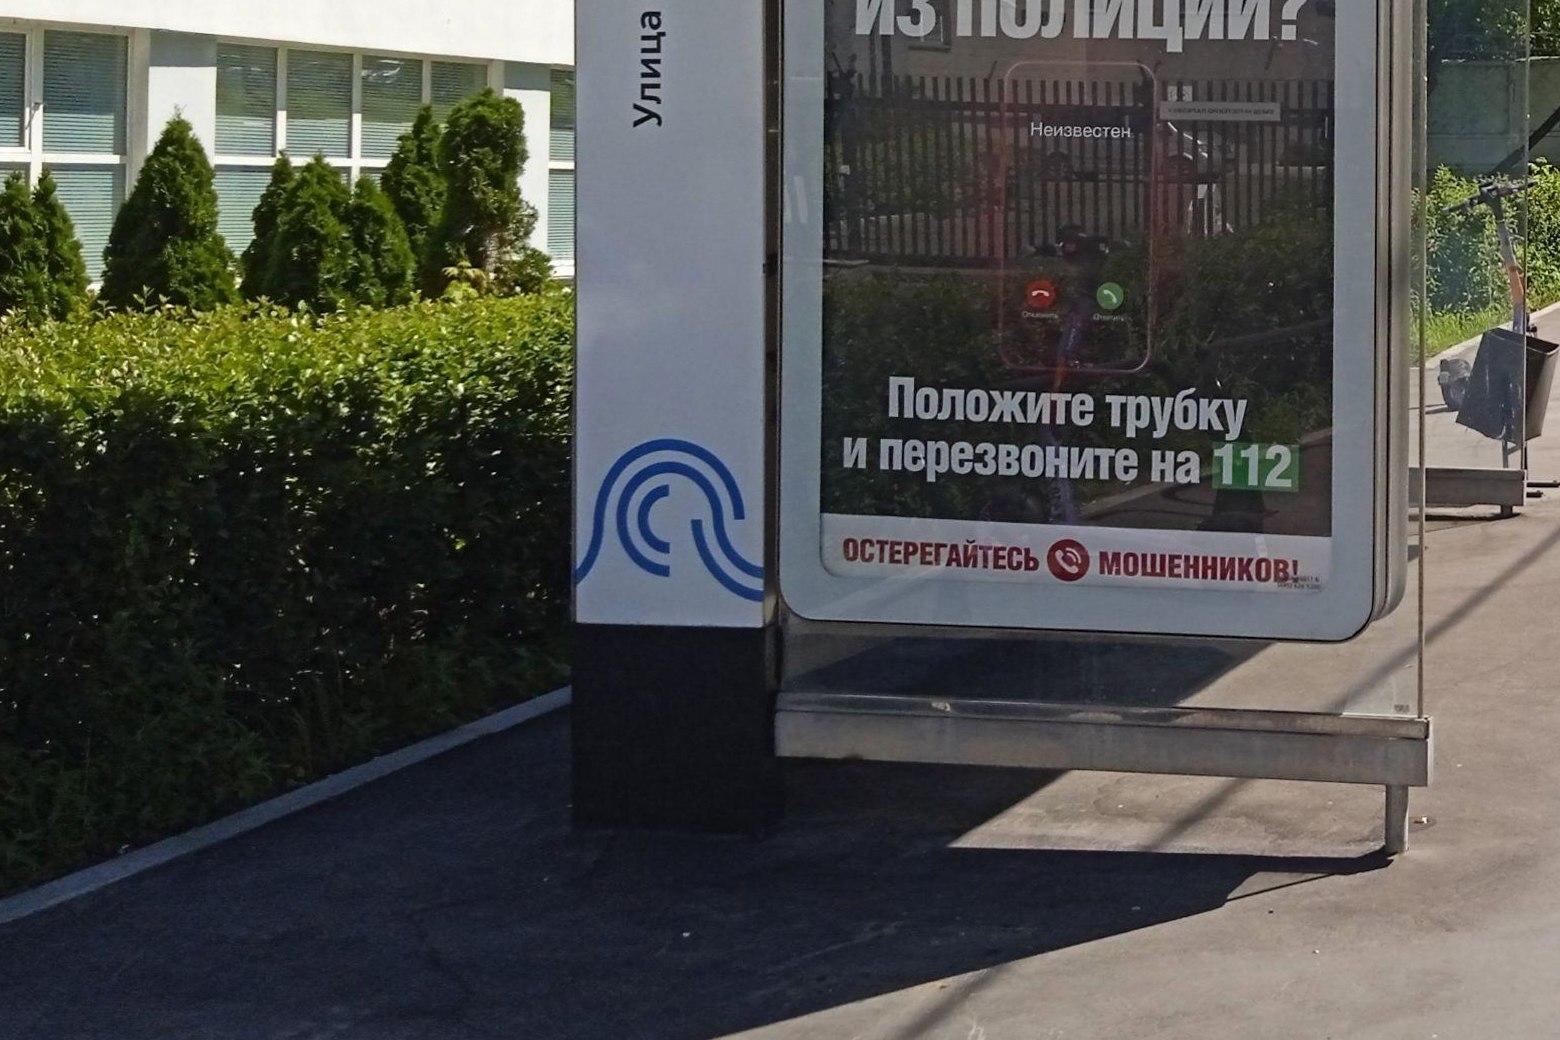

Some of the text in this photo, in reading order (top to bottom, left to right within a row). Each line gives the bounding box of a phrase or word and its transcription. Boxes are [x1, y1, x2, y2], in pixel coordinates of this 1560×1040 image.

[633, 11, 667, 128] Улица
[1030, 121, 1131, 139] Неизвестен
[888, 376, 1247, 441] Положите трубку
[843, 437, 1292, 488] и перезвоните на 112
[843, 537, 1299, 584] ОСТЕРЕГАЙТЕСЬ МОШЕННИКОВ!
